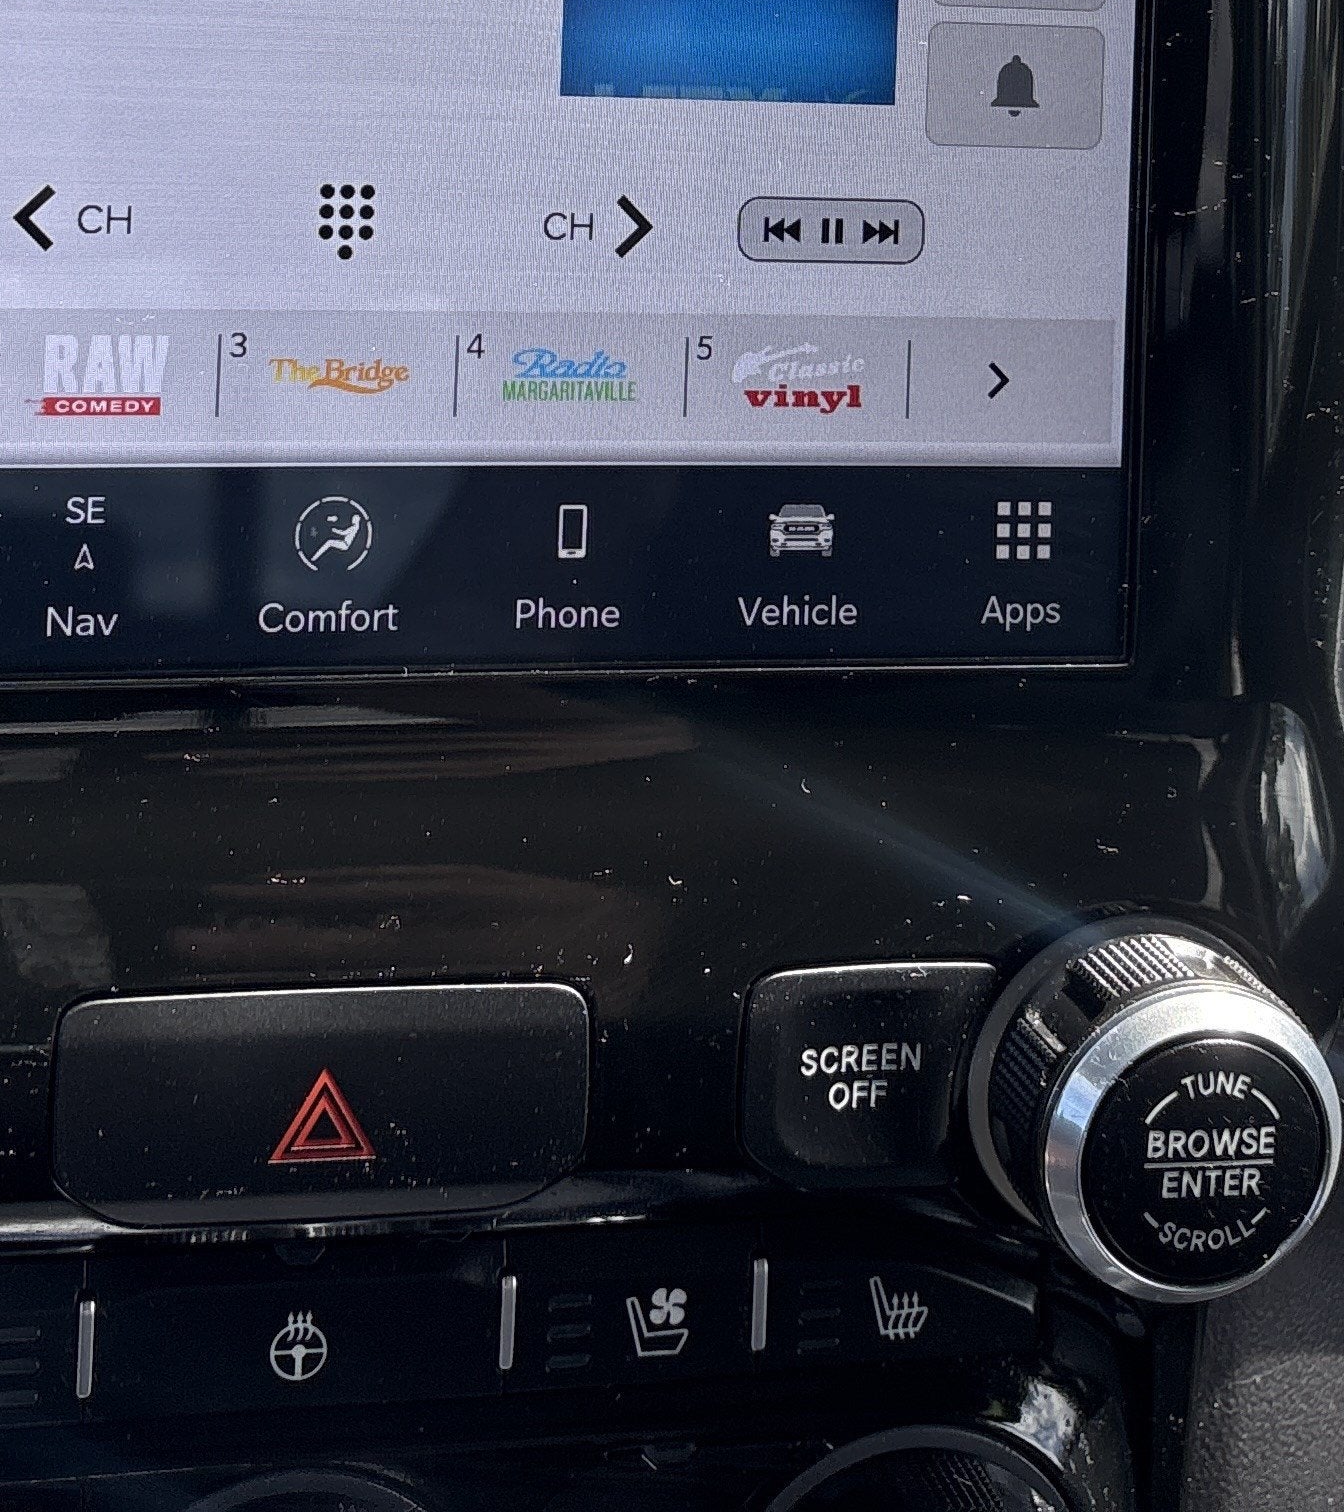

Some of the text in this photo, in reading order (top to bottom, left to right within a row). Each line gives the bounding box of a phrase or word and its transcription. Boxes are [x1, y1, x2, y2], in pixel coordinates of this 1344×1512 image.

[77, 204, 132, 235] CH
[543, 211, 594, 241] CH
[229, 332, 248, 358] 3
[466, 333, 485, 359] 4
[696, 335, 713, 361] 5
[43, 334, 171, 393] RAW
[323, 357, 410, 390] Bridge
[512, 347, 628, 379] Radio
[55, 399, 154, 413] COMEDY
[502, 380, 638, 402] MARGARITAVILLE
[743, 383, 862, 414] vinyl
[65, 496, 106, 524] SE
[46, 605, 119, 637] Nav
[258, 599, 399, 633] Comfort
[515, 597, 620, 629] Phone
[737, 594, 858, 627] Vehicle
[980, 595, 1061, 632] Apps
[800, 1042, 922, 1078] SCREEN
[828, 1080, 887, 1111] OFF
[1180, 1071, 1253, 1101] TUNE
[1145, 1125, 1277, 1160] BROWSE
[1160, 1167, 1262, 1200] ENTER
[1158, 1218, 1257, 1253] SCROLL
